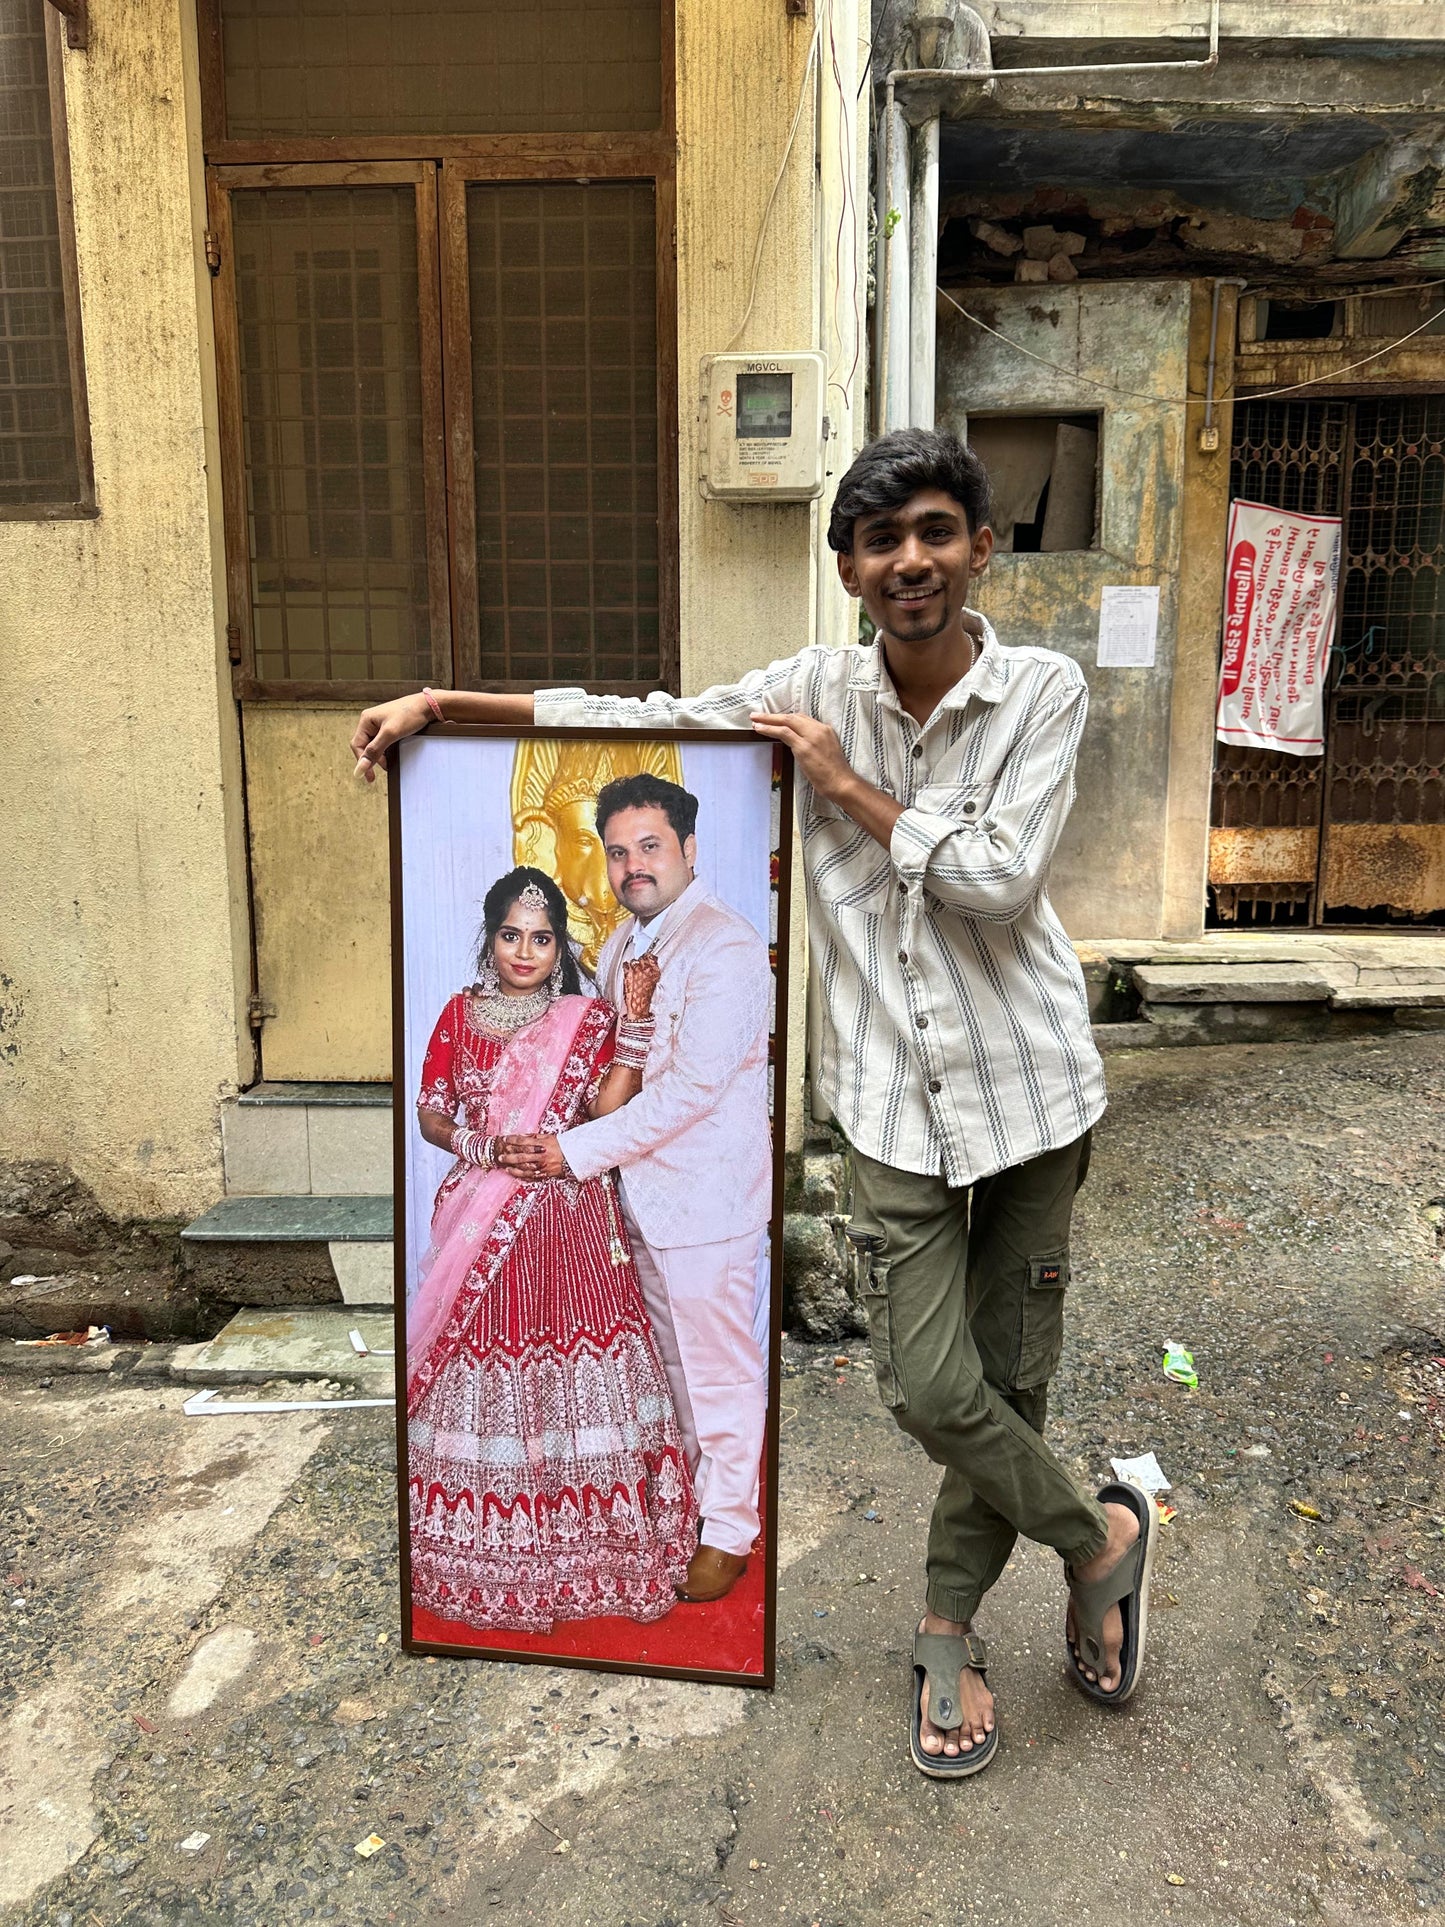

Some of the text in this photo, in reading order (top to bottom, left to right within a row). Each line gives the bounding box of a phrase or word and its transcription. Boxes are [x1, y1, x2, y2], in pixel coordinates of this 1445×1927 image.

[747, 362, 782, 371] MGVCL
[1226, 570, 1252, 626] ચેતવણી
[1240, 686, 1255, 720] આથી
